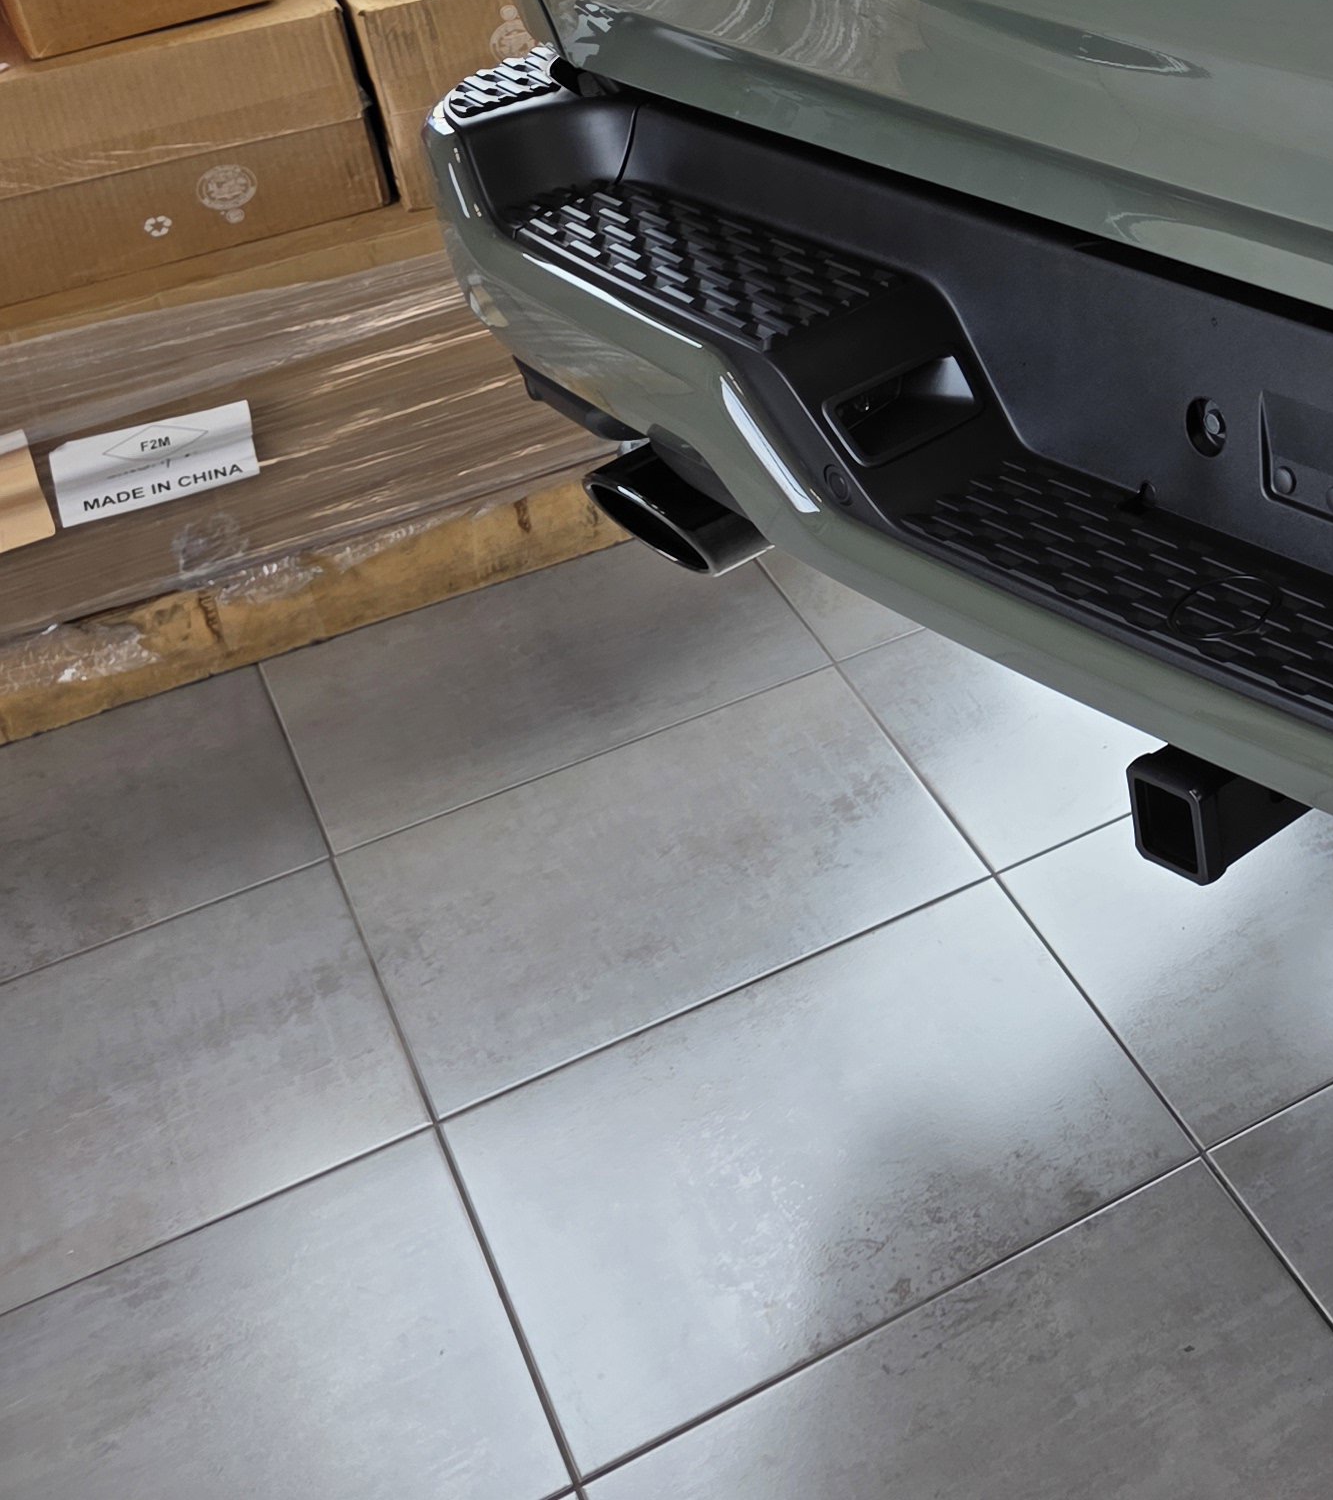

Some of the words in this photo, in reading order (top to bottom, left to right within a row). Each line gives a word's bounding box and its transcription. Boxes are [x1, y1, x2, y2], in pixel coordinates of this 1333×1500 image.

[140, 436, 171, 452] F2M
[83, 486, 145, 511] MADE
[151, 480, 171, 496] IN
[178, 463, 243, 488] CHINA
